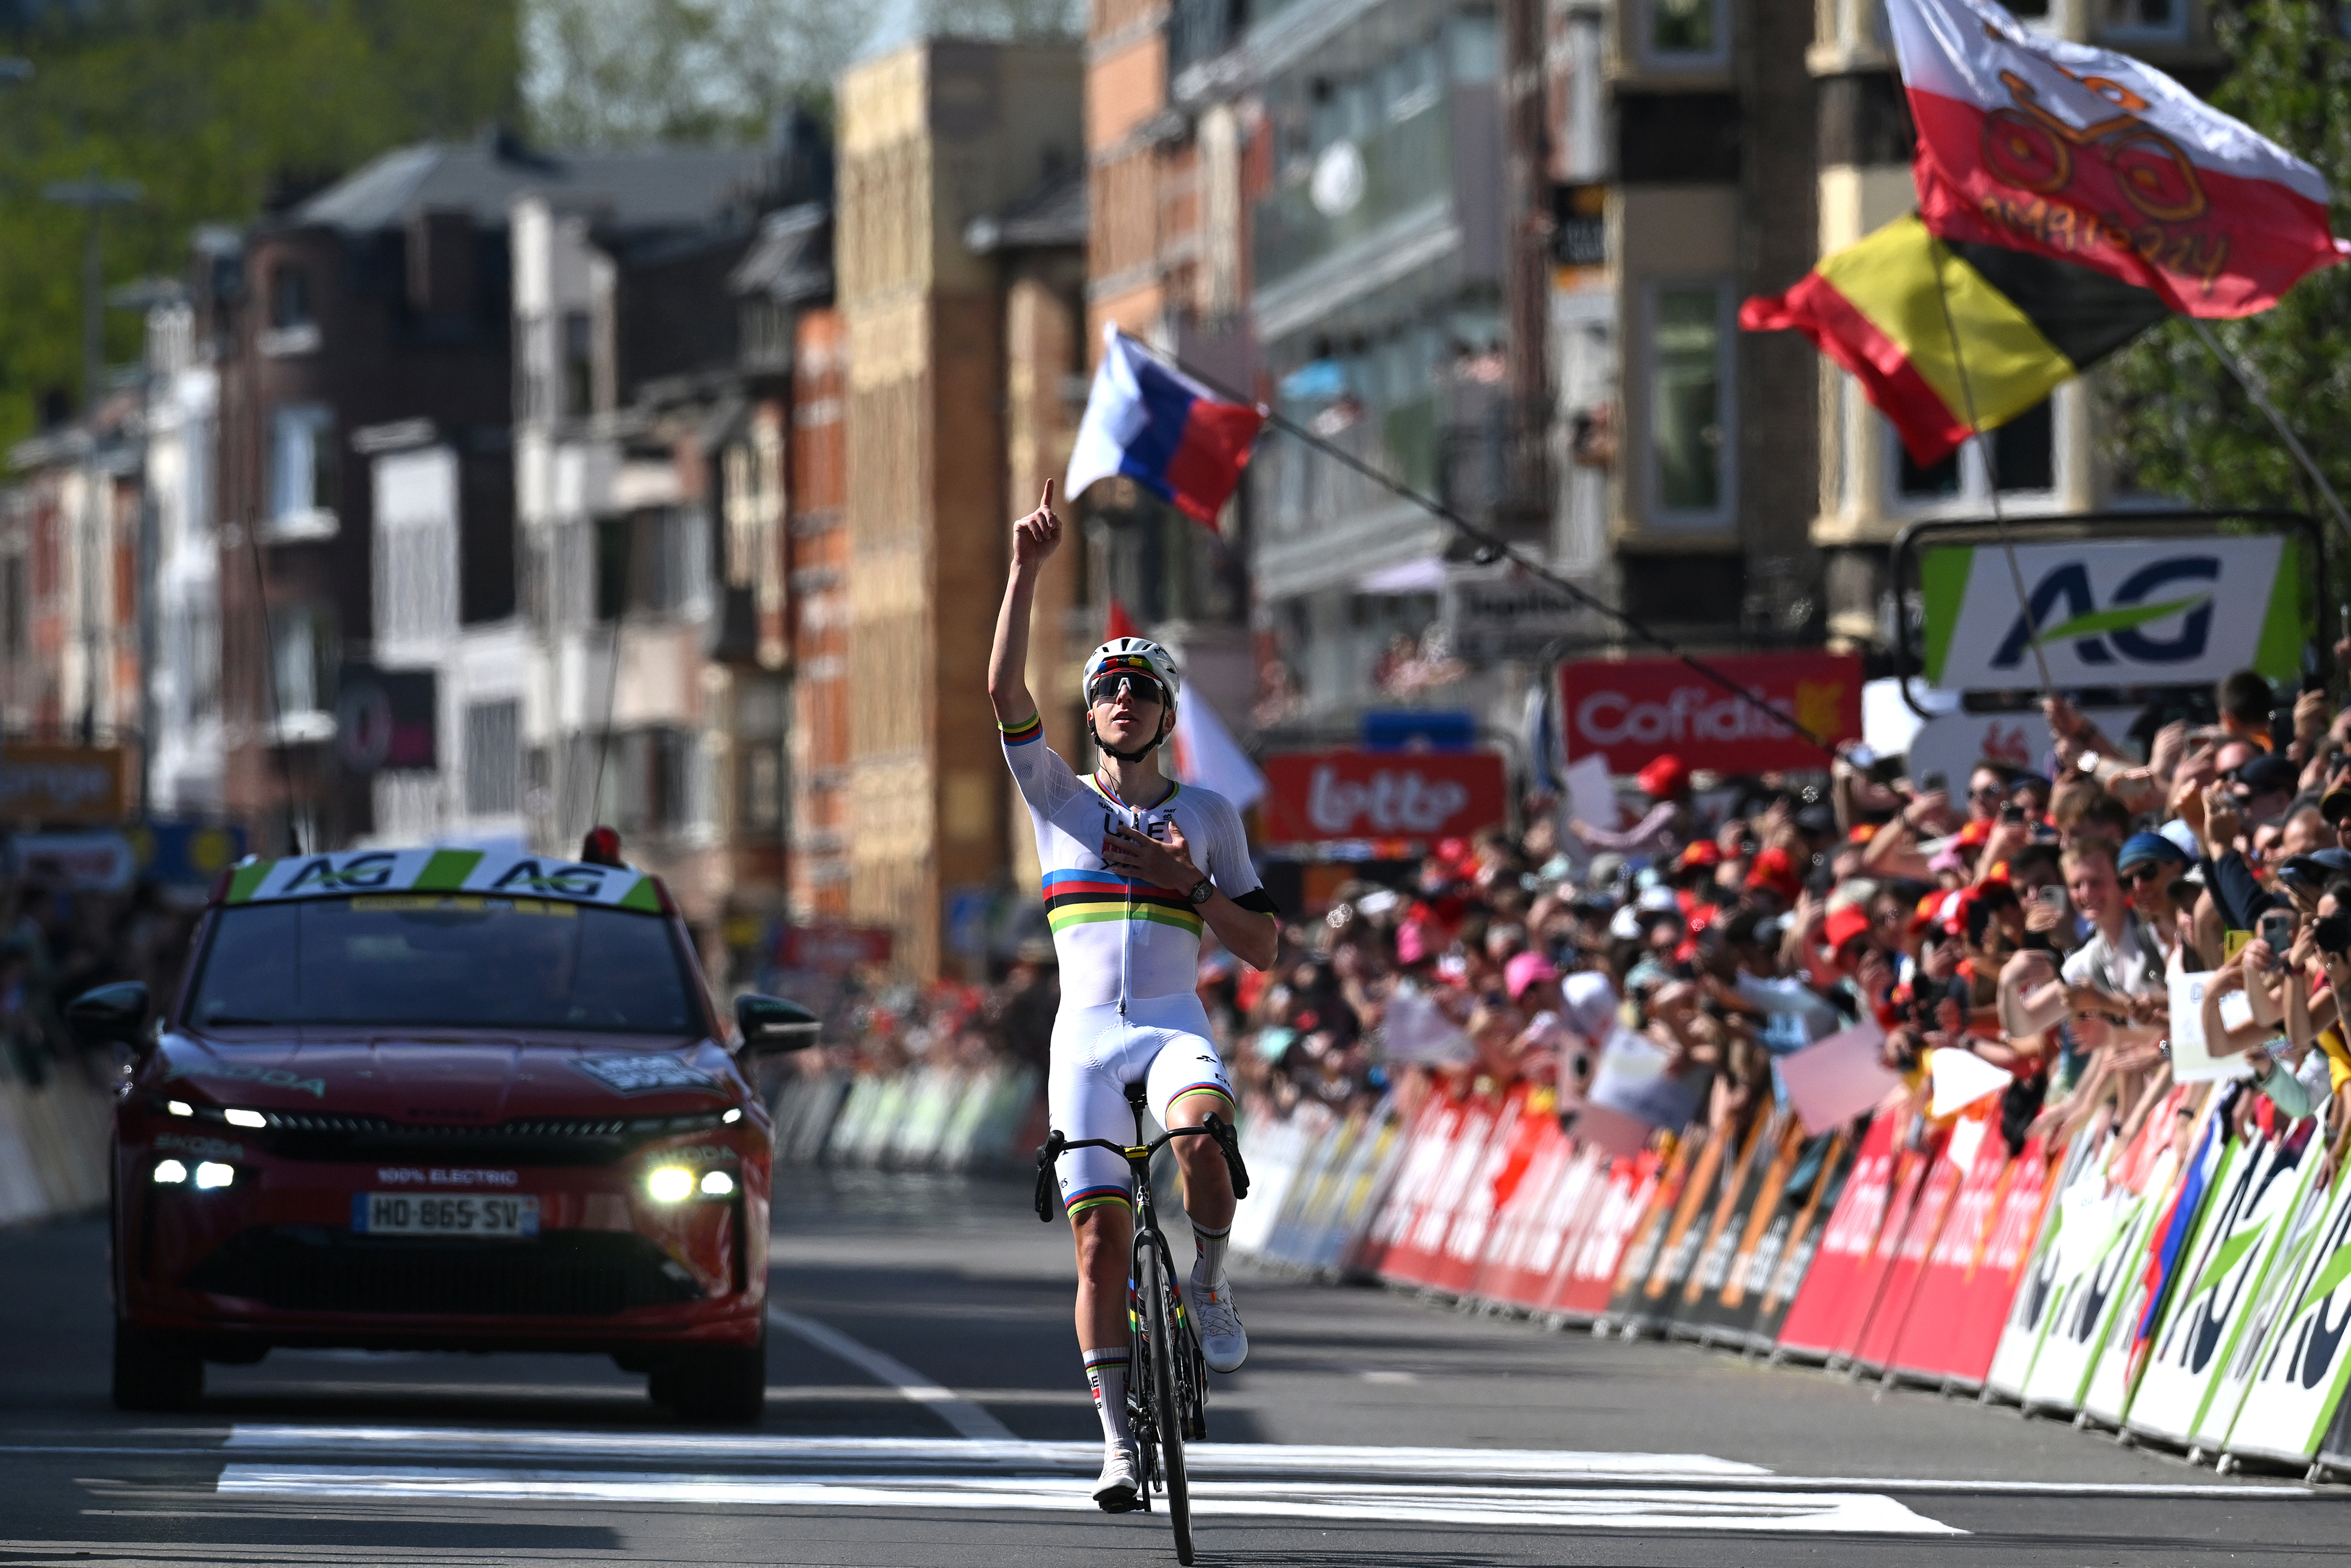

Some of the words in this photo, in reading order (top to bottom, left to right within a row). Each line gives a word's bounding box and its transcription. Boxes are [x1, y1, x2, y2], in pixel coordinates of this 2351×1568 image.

[1989, 556, 2220, 669] AG
[1575, 685, 1794, 745] Cofidis
[1101, 802, 1113, 812] UCI
[1104, 813, 1166, 841] UE
[281, 852, 397, 893] AG
[490, 860, 607, 897] AG
[378, 1167, 426, 1184] 100%
[428, 1168, 518, 1187] ELECTRIC
